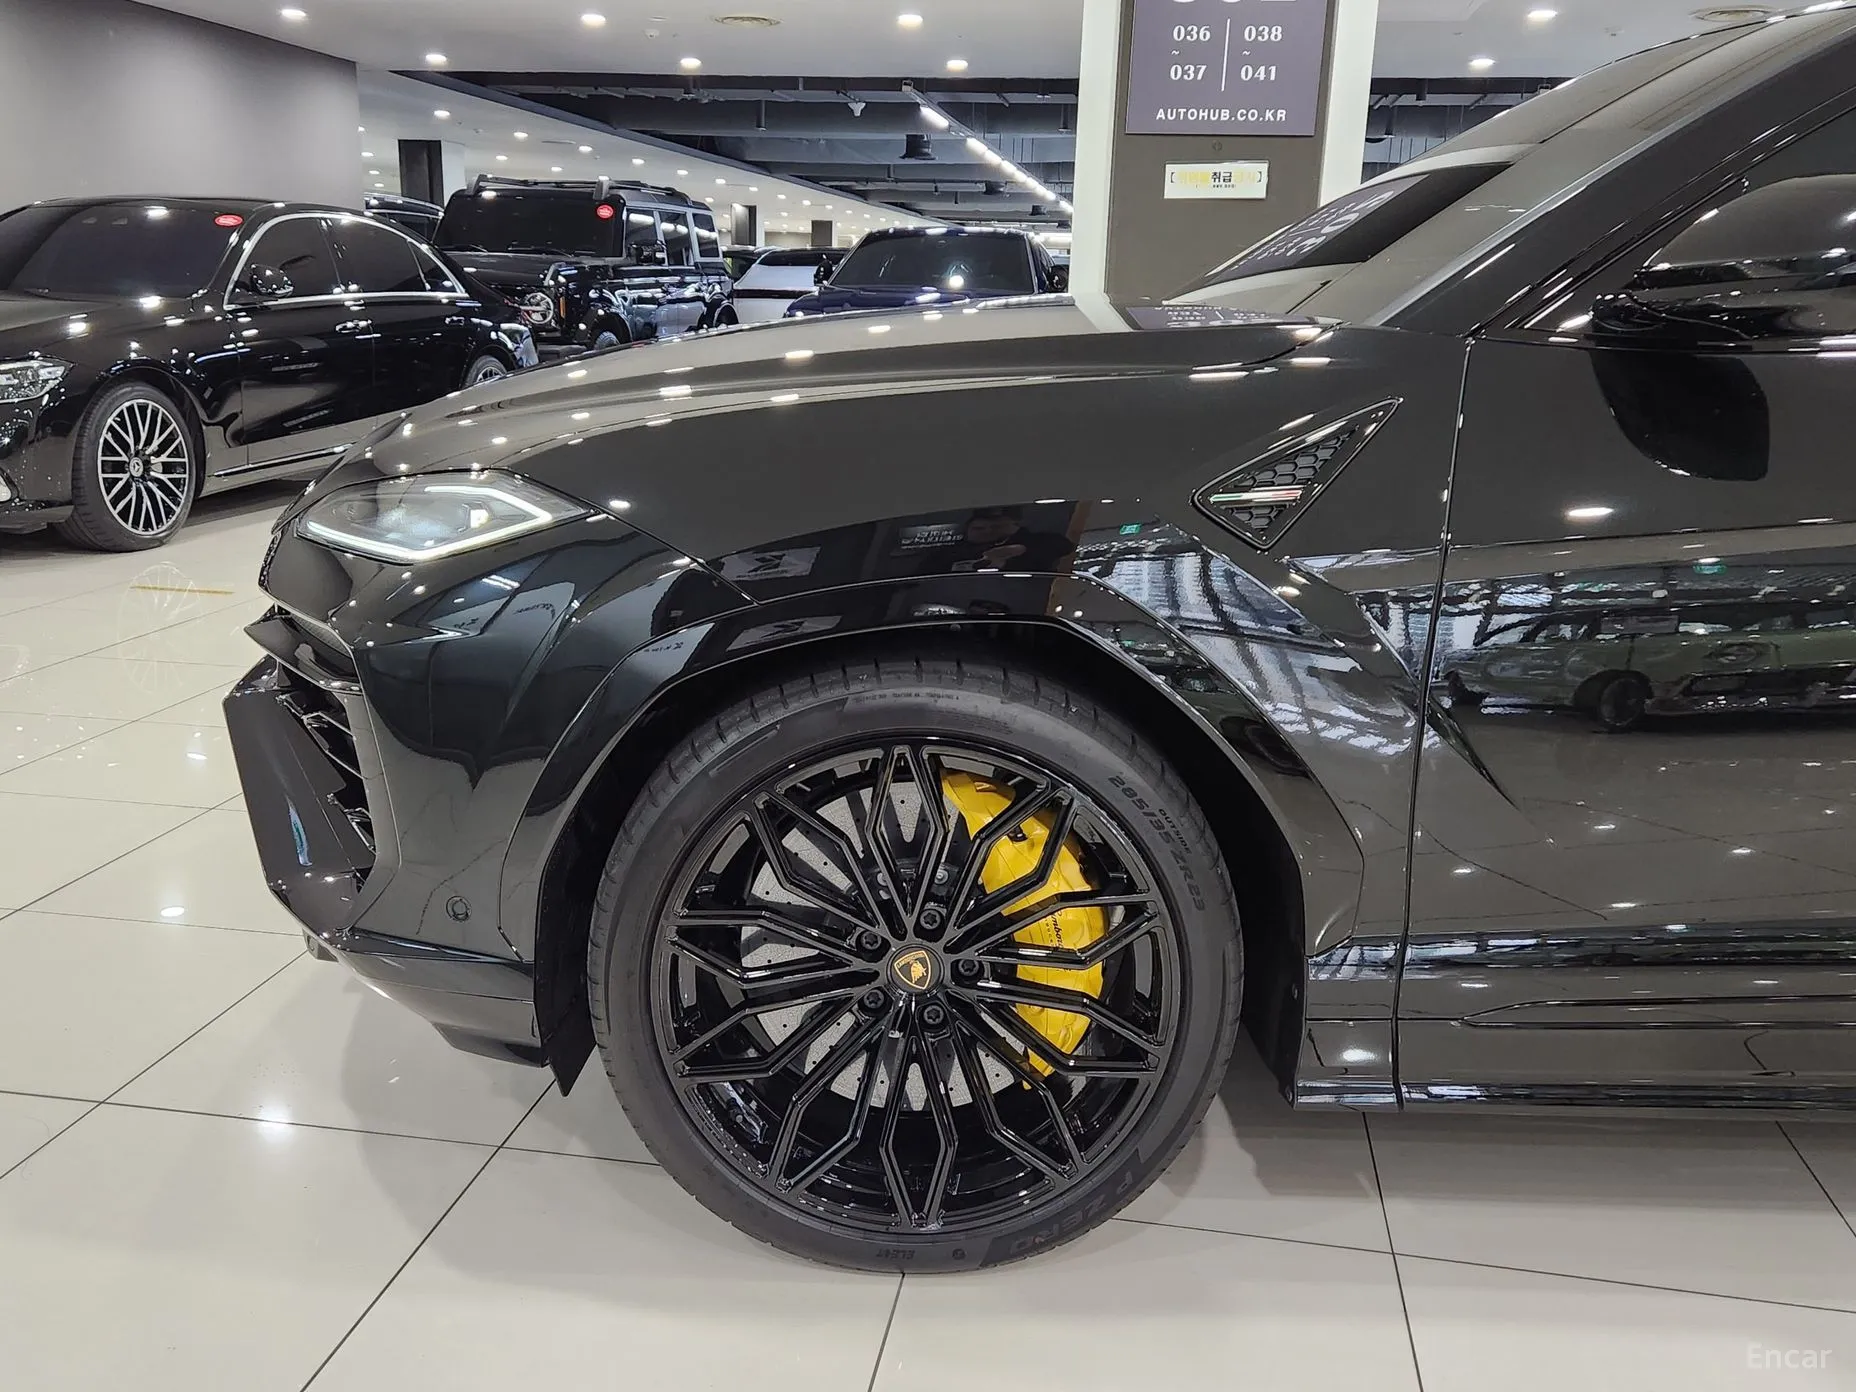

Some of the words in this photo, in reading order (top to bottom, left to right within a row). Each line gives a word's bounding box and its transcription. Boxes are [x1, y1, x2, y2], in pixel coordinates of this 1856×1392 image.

[1172, 25, 1211, 42] 036
[1243, 25, 1283, 42] 038
[1169, 64, 1207, 81] 037
[1240, 65, 1277, 81] 041
[1155, 107, 1287, 122] AUTOHUB.CO.KR
[1108, 774, 1176, 845] 285/35
